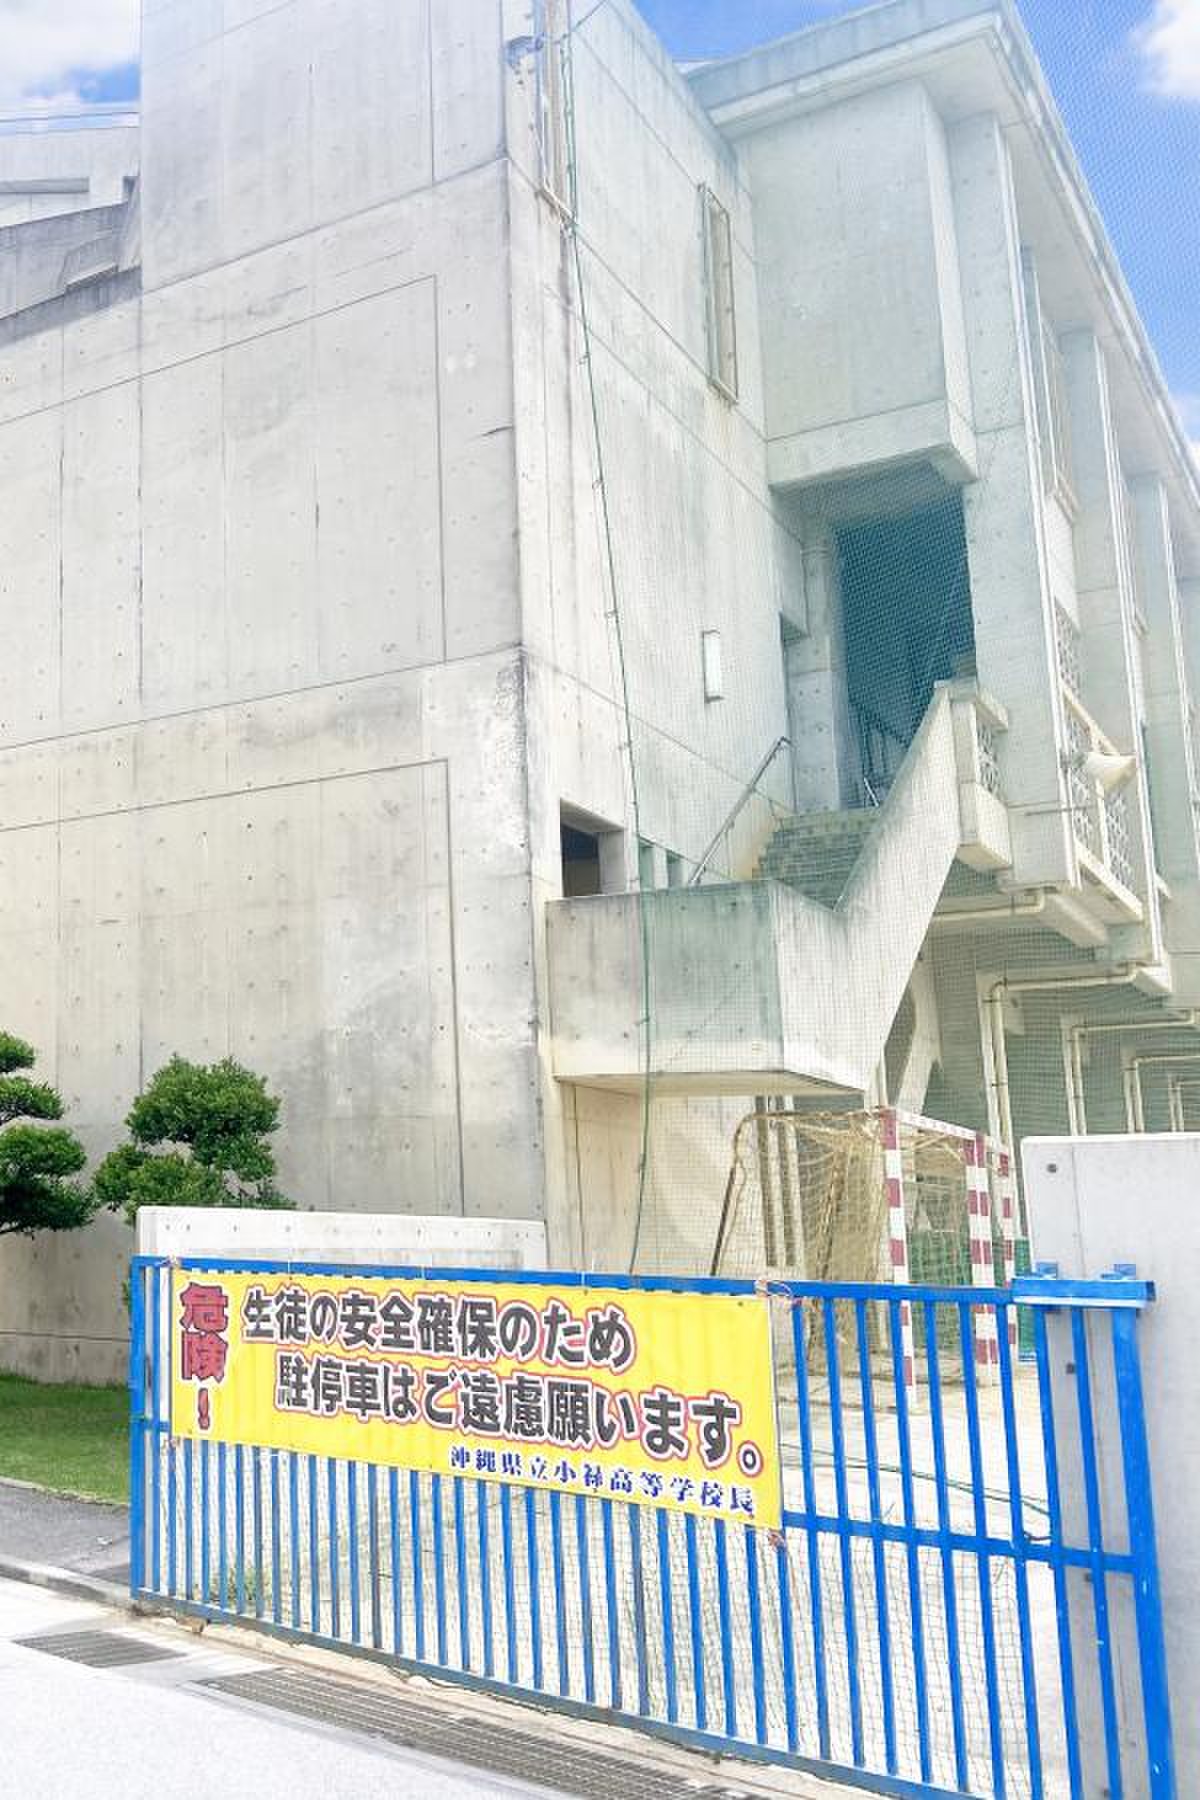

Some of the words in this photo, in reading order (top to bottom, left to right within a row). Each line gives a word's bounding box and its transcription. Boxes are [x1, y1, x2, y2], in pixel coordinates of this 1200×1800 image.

[243, 1288, 632, 1369] 生徒の安全確保のため
[276, 1354, 758, 1471] 駐停車はご遠慮願います。
[450, 1445, 755, 1513] 沖縄県立小禄高等学校長
